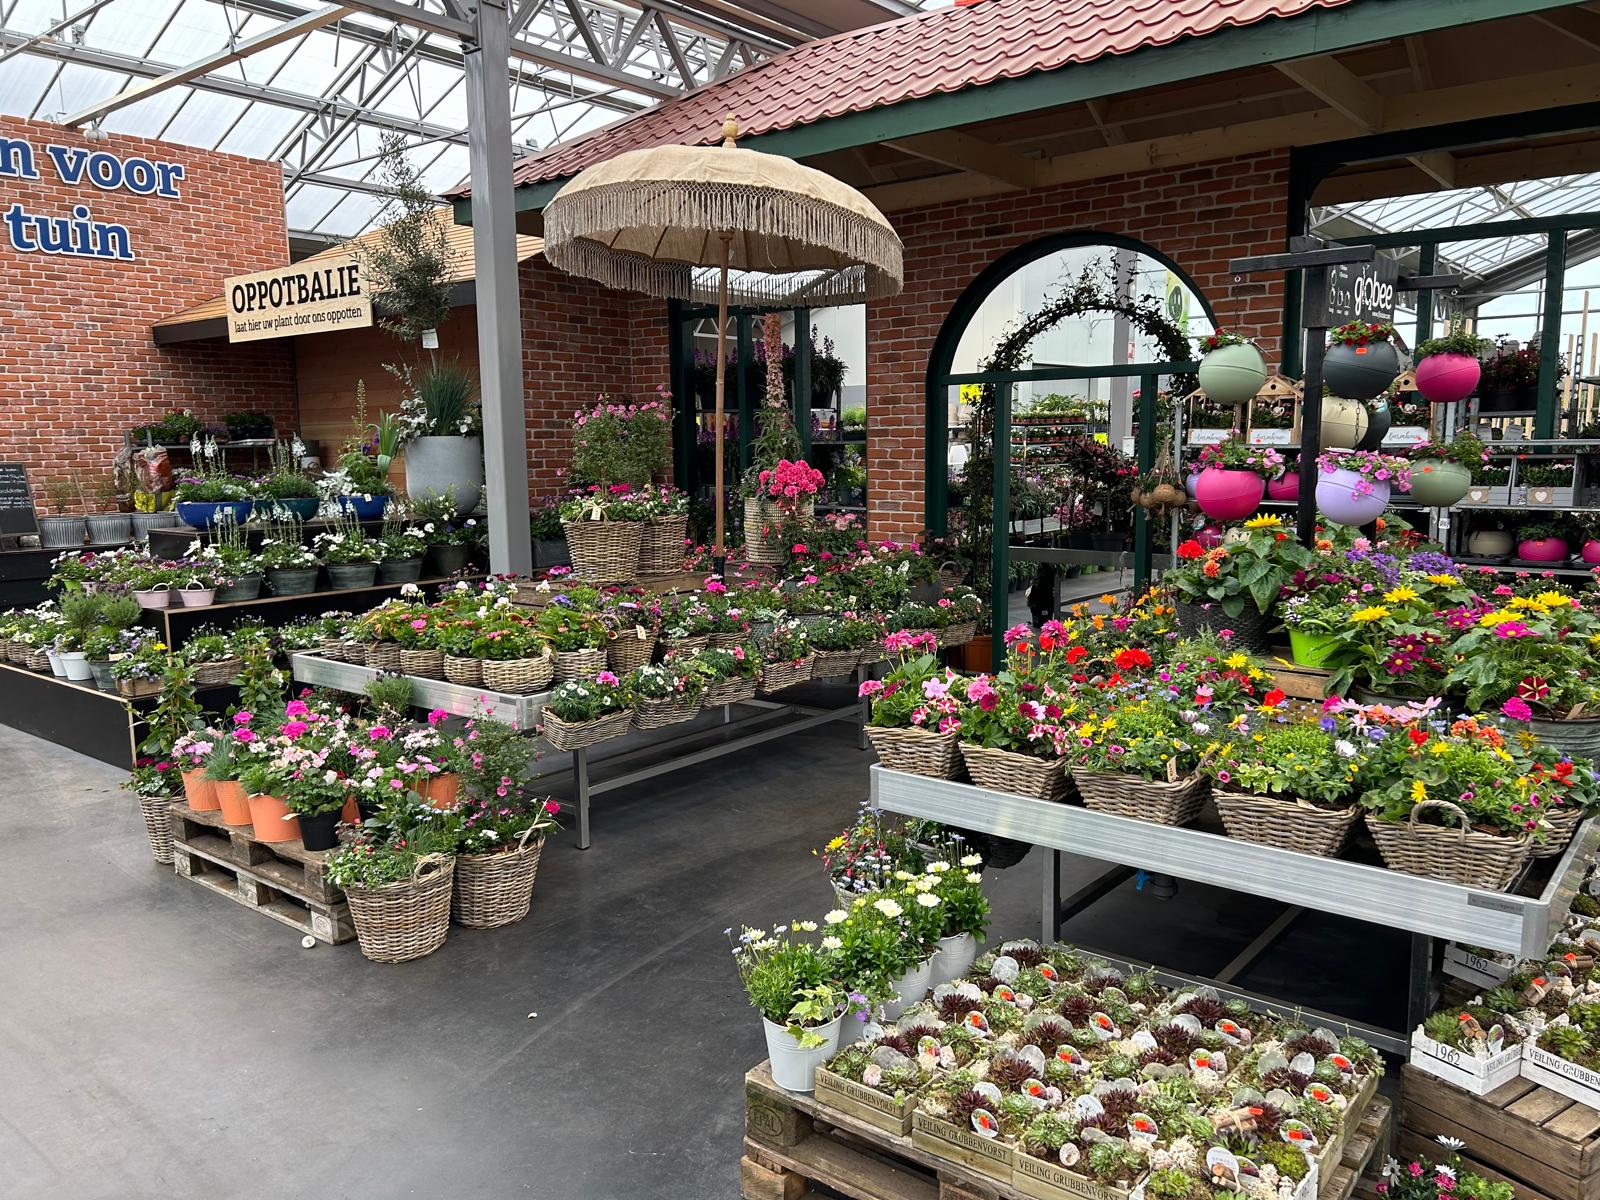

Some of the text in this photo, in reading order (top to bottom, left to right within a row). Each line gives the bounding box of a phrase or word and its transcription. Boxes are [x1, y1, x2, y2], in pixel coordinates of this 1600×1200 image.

[47, 144, 184, 199] voor
[4, 205, 135, 261] tuin
[232, 265, 361, 313] OPPOTBALIE
[234, 307, 362, 333] laat hier uw plant door ons oppotten
[1465, 953, 1488, 972] 1962
[1435, 1043, 1460, 1066] 1962
[1529, 1048, 1560, 1070] VEILING
[820, 1073, 896, 1113] VEILING GRUBBENVORST
[918, 1117, 1007, 1160] VEILING GRUBBENVORST
[1019, 1159, 1120, 1200] VEILING GRUBBENVORST
